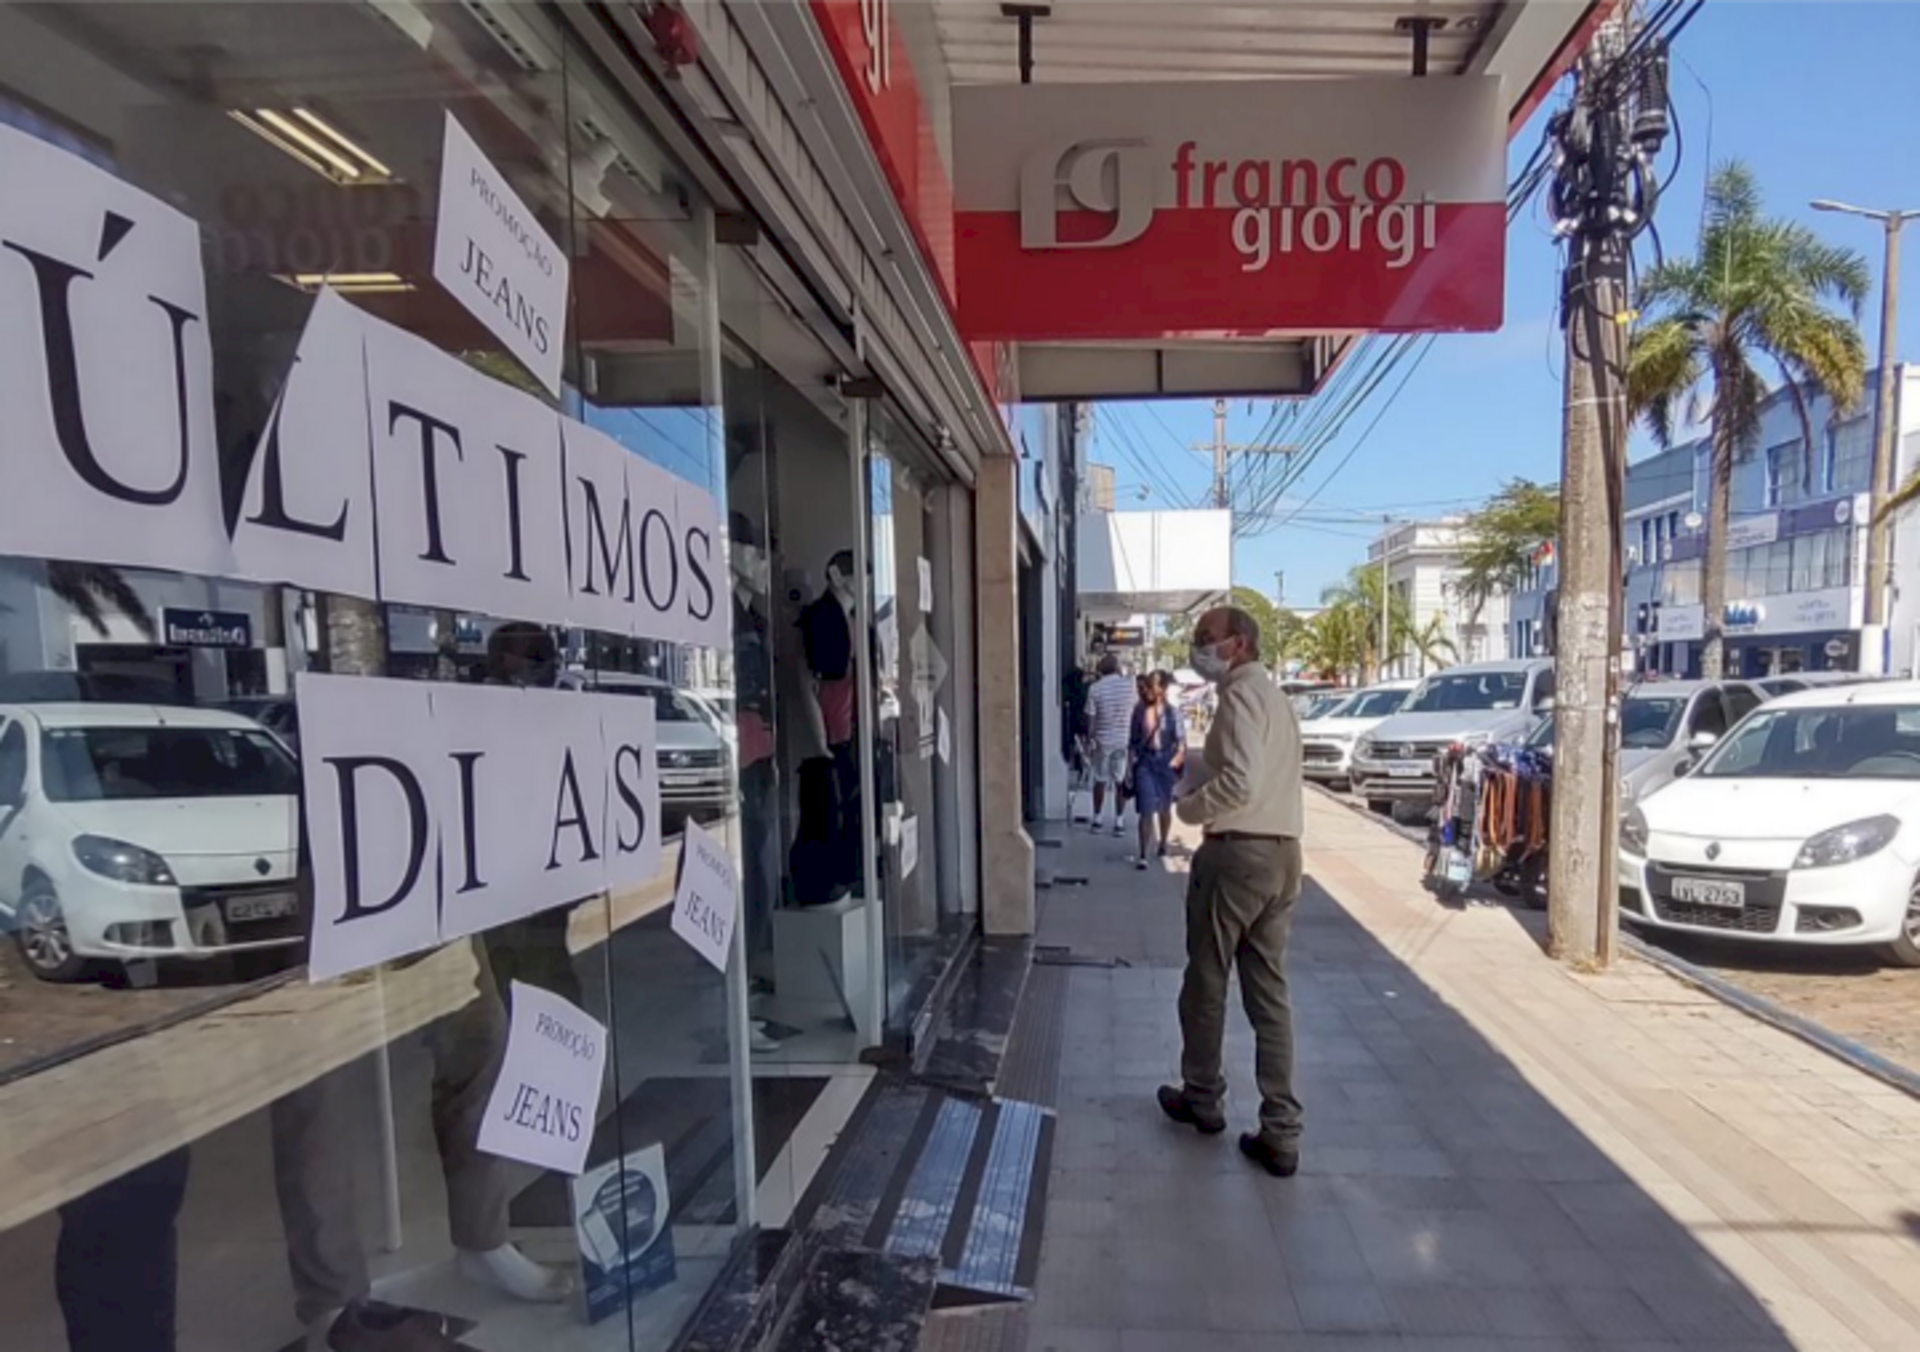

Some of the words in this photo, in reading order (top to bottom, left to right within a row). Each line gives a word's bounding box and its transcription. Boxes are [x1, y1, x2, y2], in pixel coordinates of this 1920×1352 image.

[1171, 141, 1406, 208] franco
[470, 168, 552, 278] PROMOÇÃO
[1232, 191, 1436, 272] giorgi
[461, 236, 550, 355] JEANS
[2, 210, 715, 621] ÚLTIMOS
[323, 744, 646, 925] DIAS
[684, 889, 727, 947] JEANS
[535, 1013, 596, 1060] PROMOÇÃO
[504, 1082, 583, 1142] JEANS
